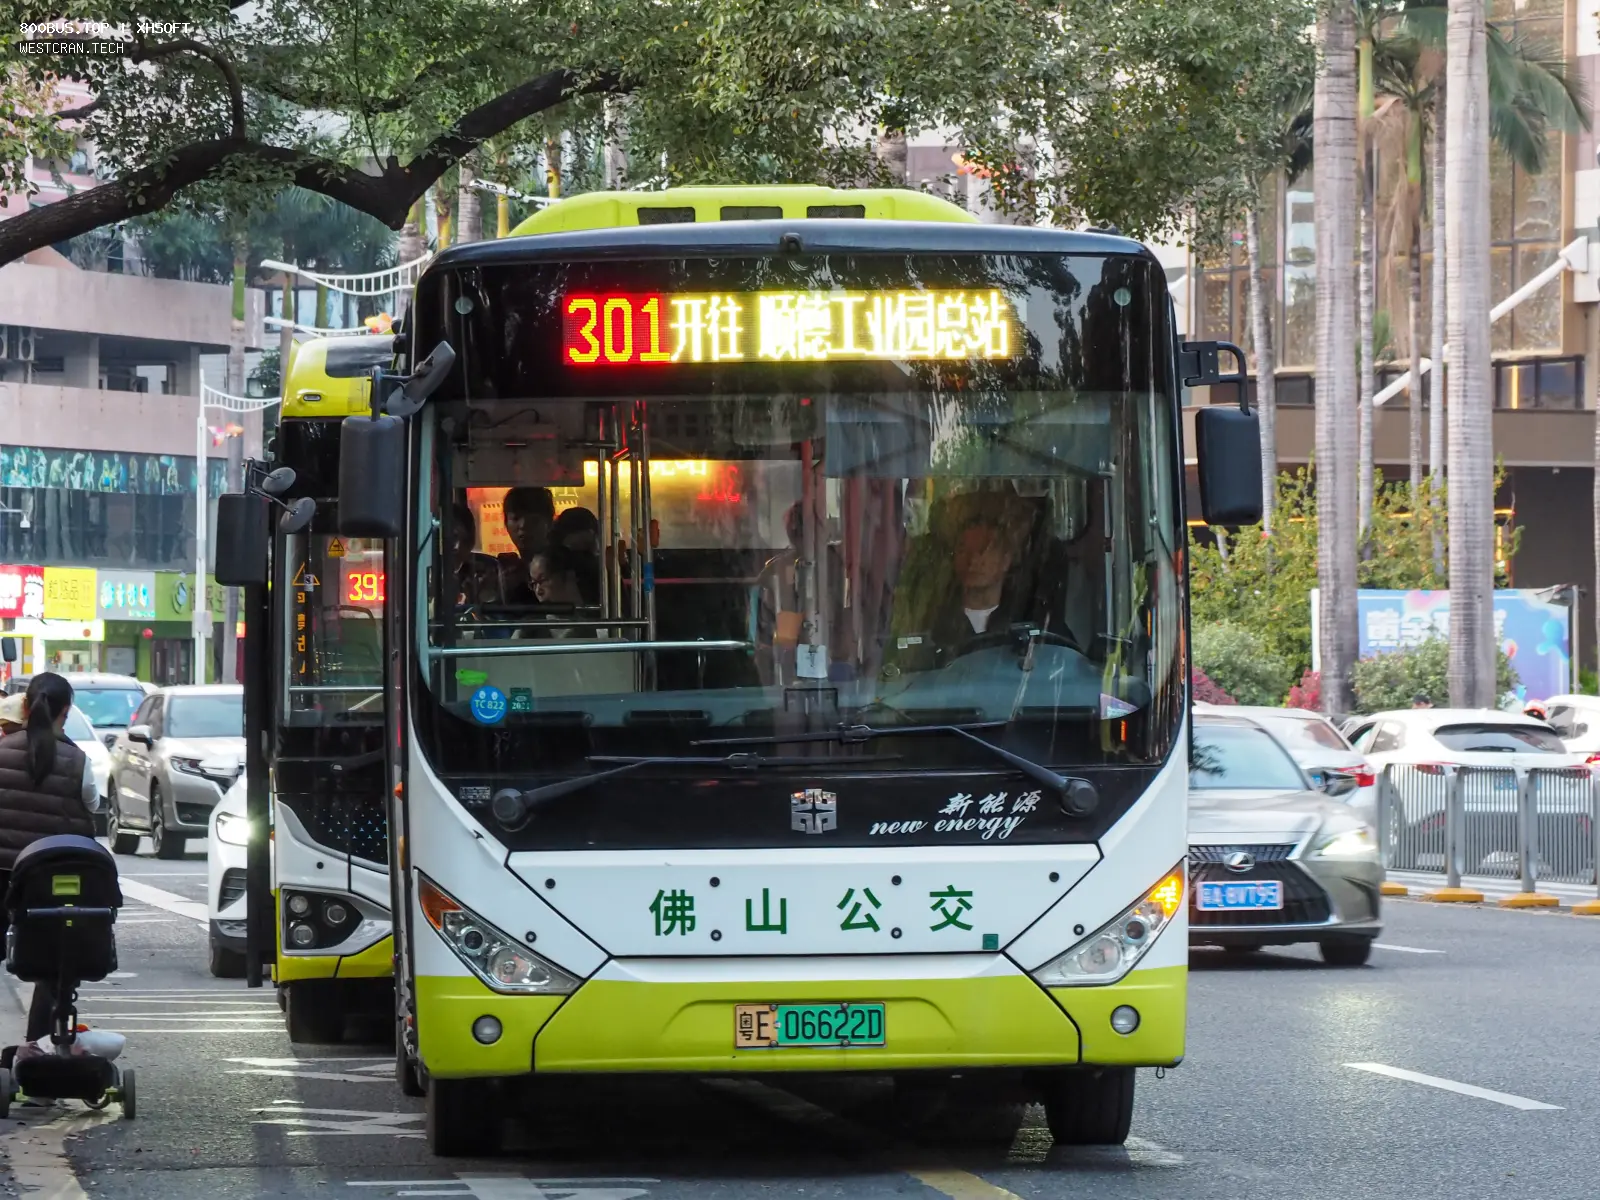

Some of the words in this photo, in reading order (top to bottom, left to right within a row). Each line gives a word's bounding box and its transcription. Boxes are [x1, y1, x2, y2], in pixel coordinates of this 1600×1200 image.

[567, 297, 671, 363] 301
[670, 295, 745, 361] 开往
[757, 290, 1009, 360] 顺德工业园总站
[474, 699, 486, 709] TC
[487, 700, 505, 710] 822
[938, 790, 1043, 818] 新能源
[869, 820, 928, 836] new
[934, 815, 1026, 841] energy
[648, 884, 974, 937] 佛山公交
